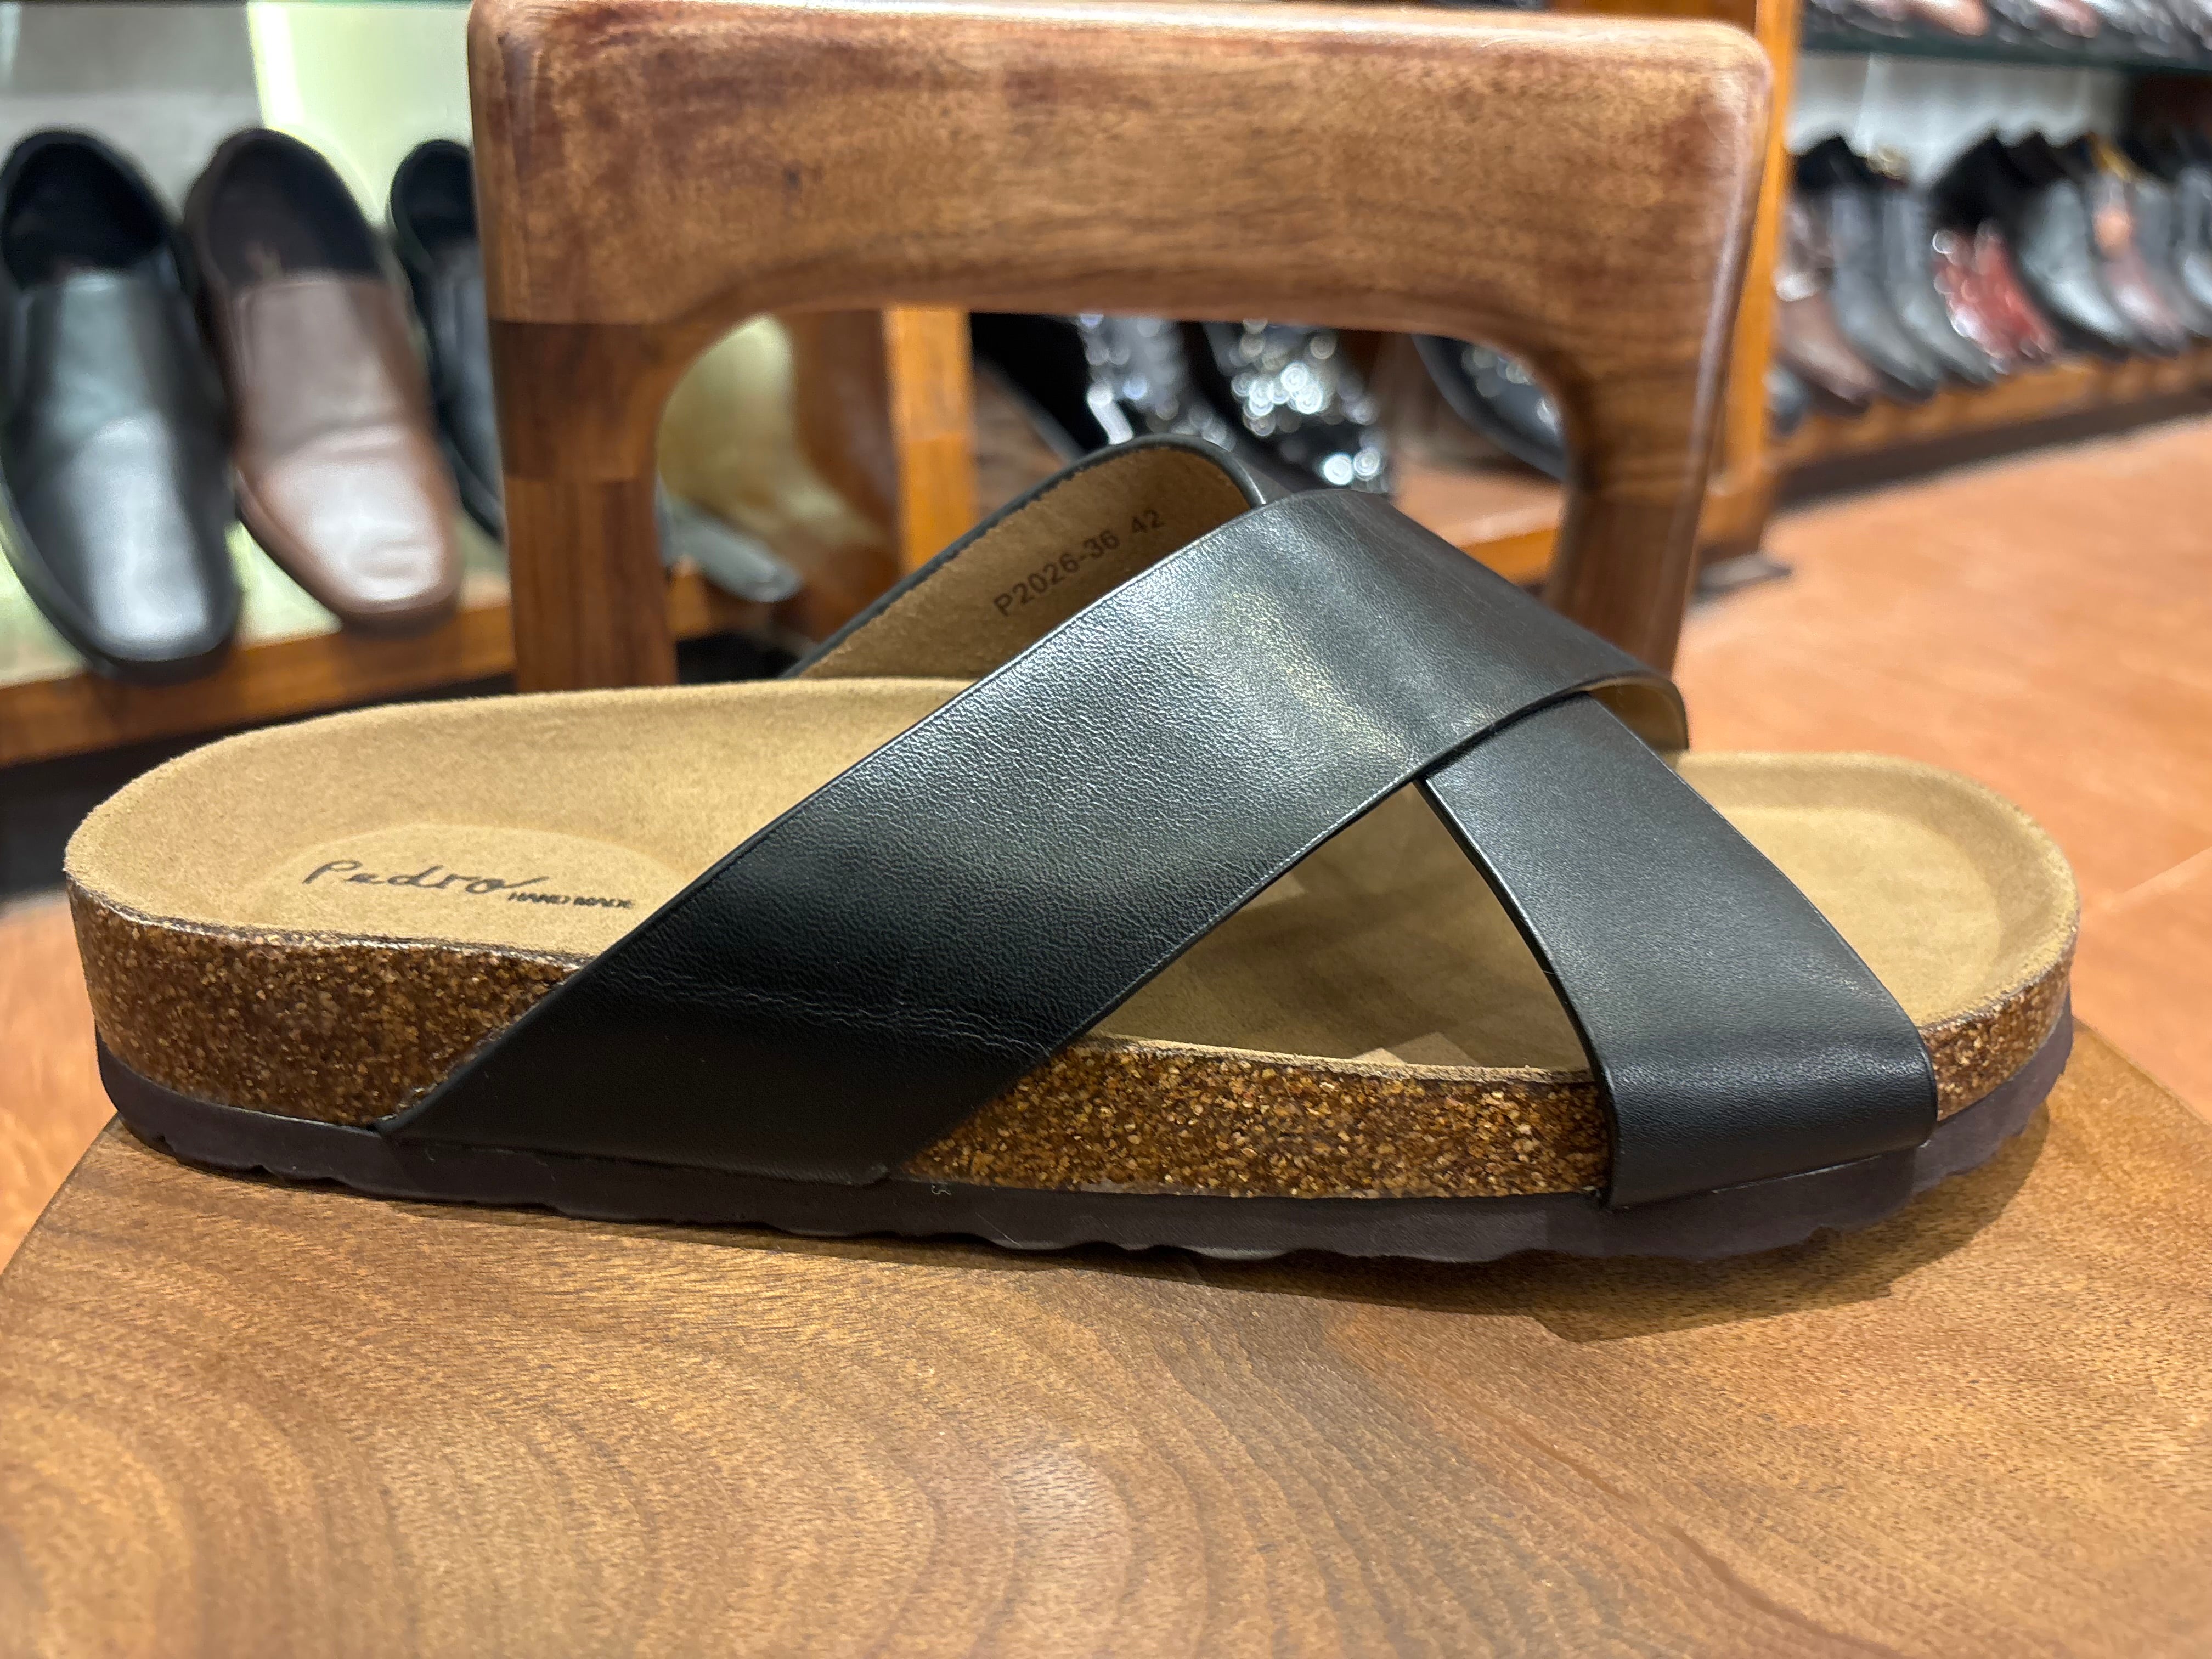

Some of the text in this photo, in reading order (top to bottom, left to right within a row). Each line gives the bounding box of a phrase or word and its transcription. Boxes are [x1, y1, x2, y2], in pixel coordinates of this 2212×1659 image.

[993, 509, 1166, 617] P2026-36 42
[302, 860, 549, 894] Pedro
[508, 891, 635, 909] HAND MADE
